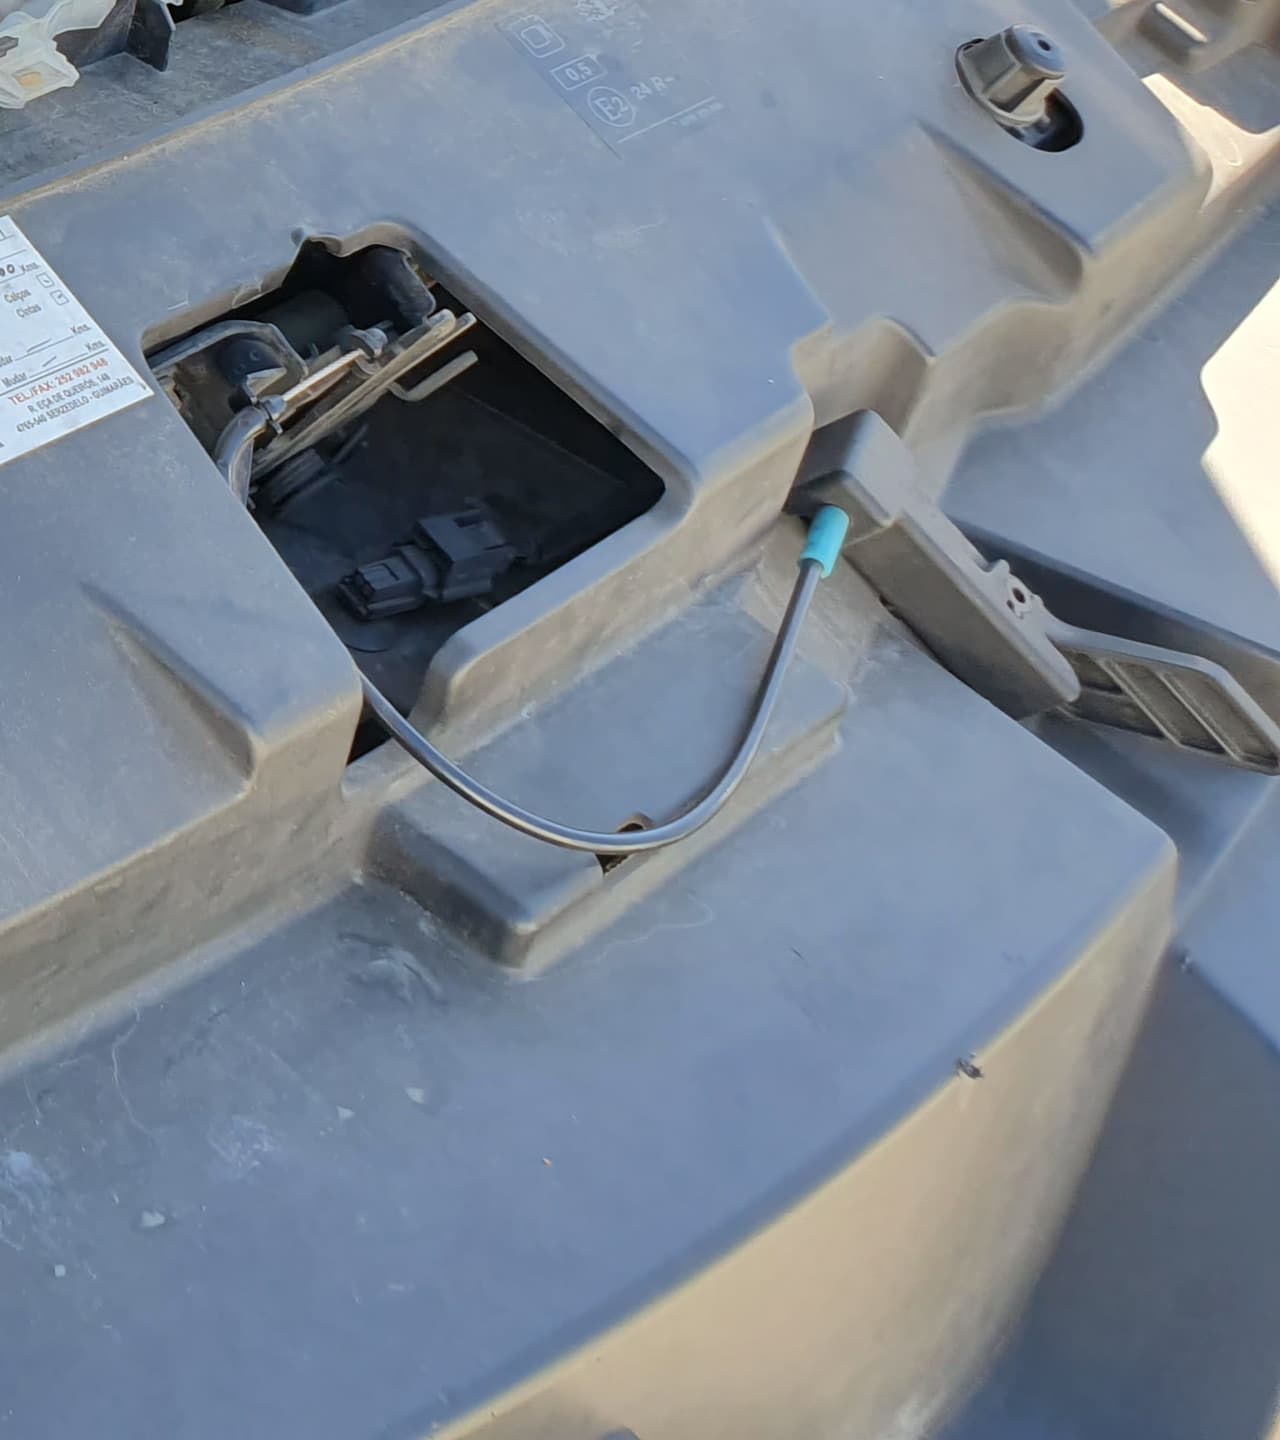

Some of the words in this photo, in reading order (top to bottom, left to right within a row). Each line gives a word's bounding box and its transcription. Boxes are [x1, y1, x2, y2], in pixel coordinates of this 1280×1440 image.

[3, 288, 32, 304] Calços
[15, 303, 42, 318] Cintas
[1, 371, 28, 388] Mudar
[91, 375, 135, 399] GUIMARÃES
